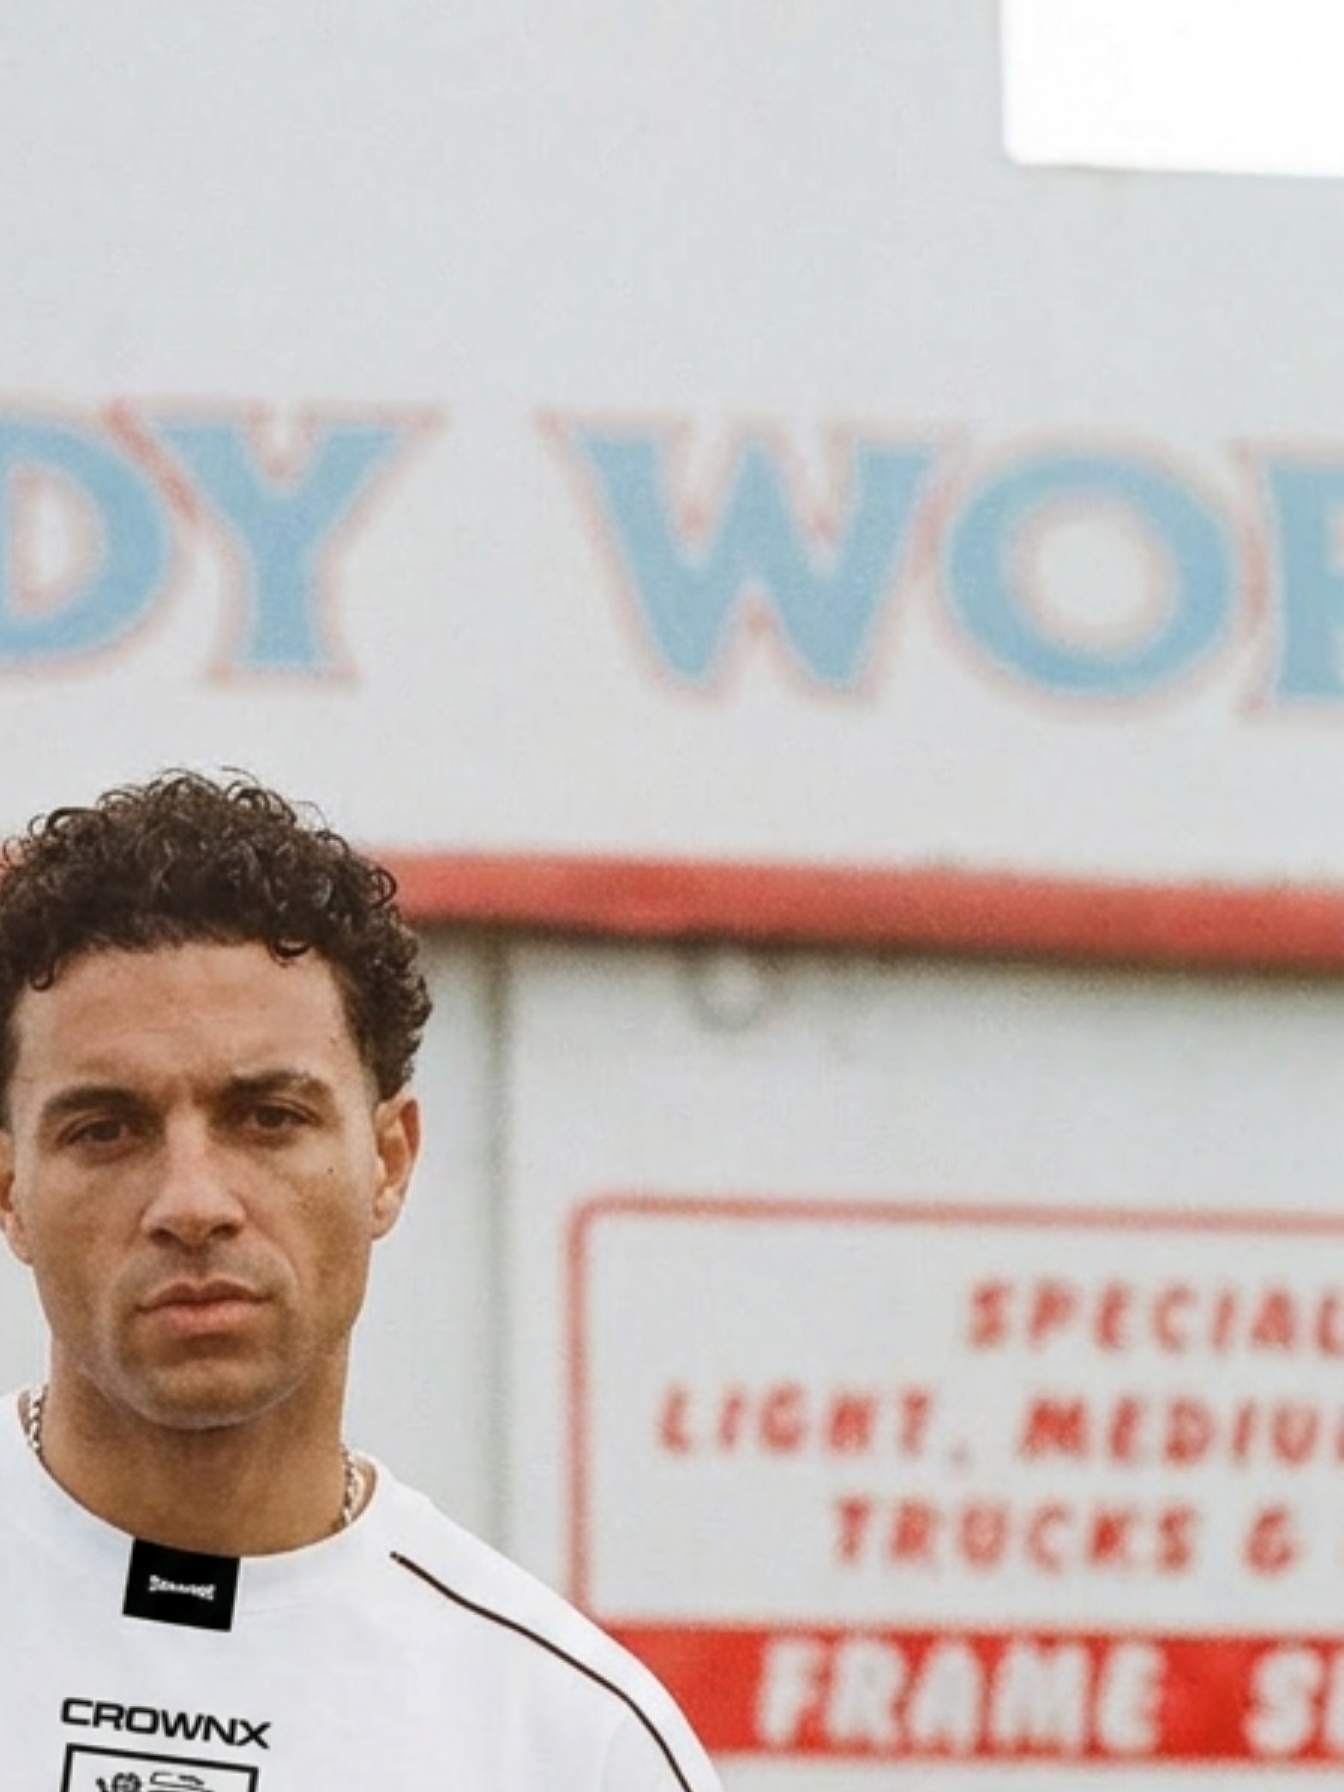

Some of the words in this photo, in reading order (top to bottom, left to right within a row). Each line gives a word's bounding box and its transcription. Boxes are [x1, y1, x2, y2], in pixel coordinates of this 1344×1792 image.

[1018, 1394, 1344, 1468] MEDIU
[832, 1492, 1198, 1576] TRUCKS
[60, 1697, 272, 1750] CROWNX
[757, 1634, 1166, 1755] FRAME
